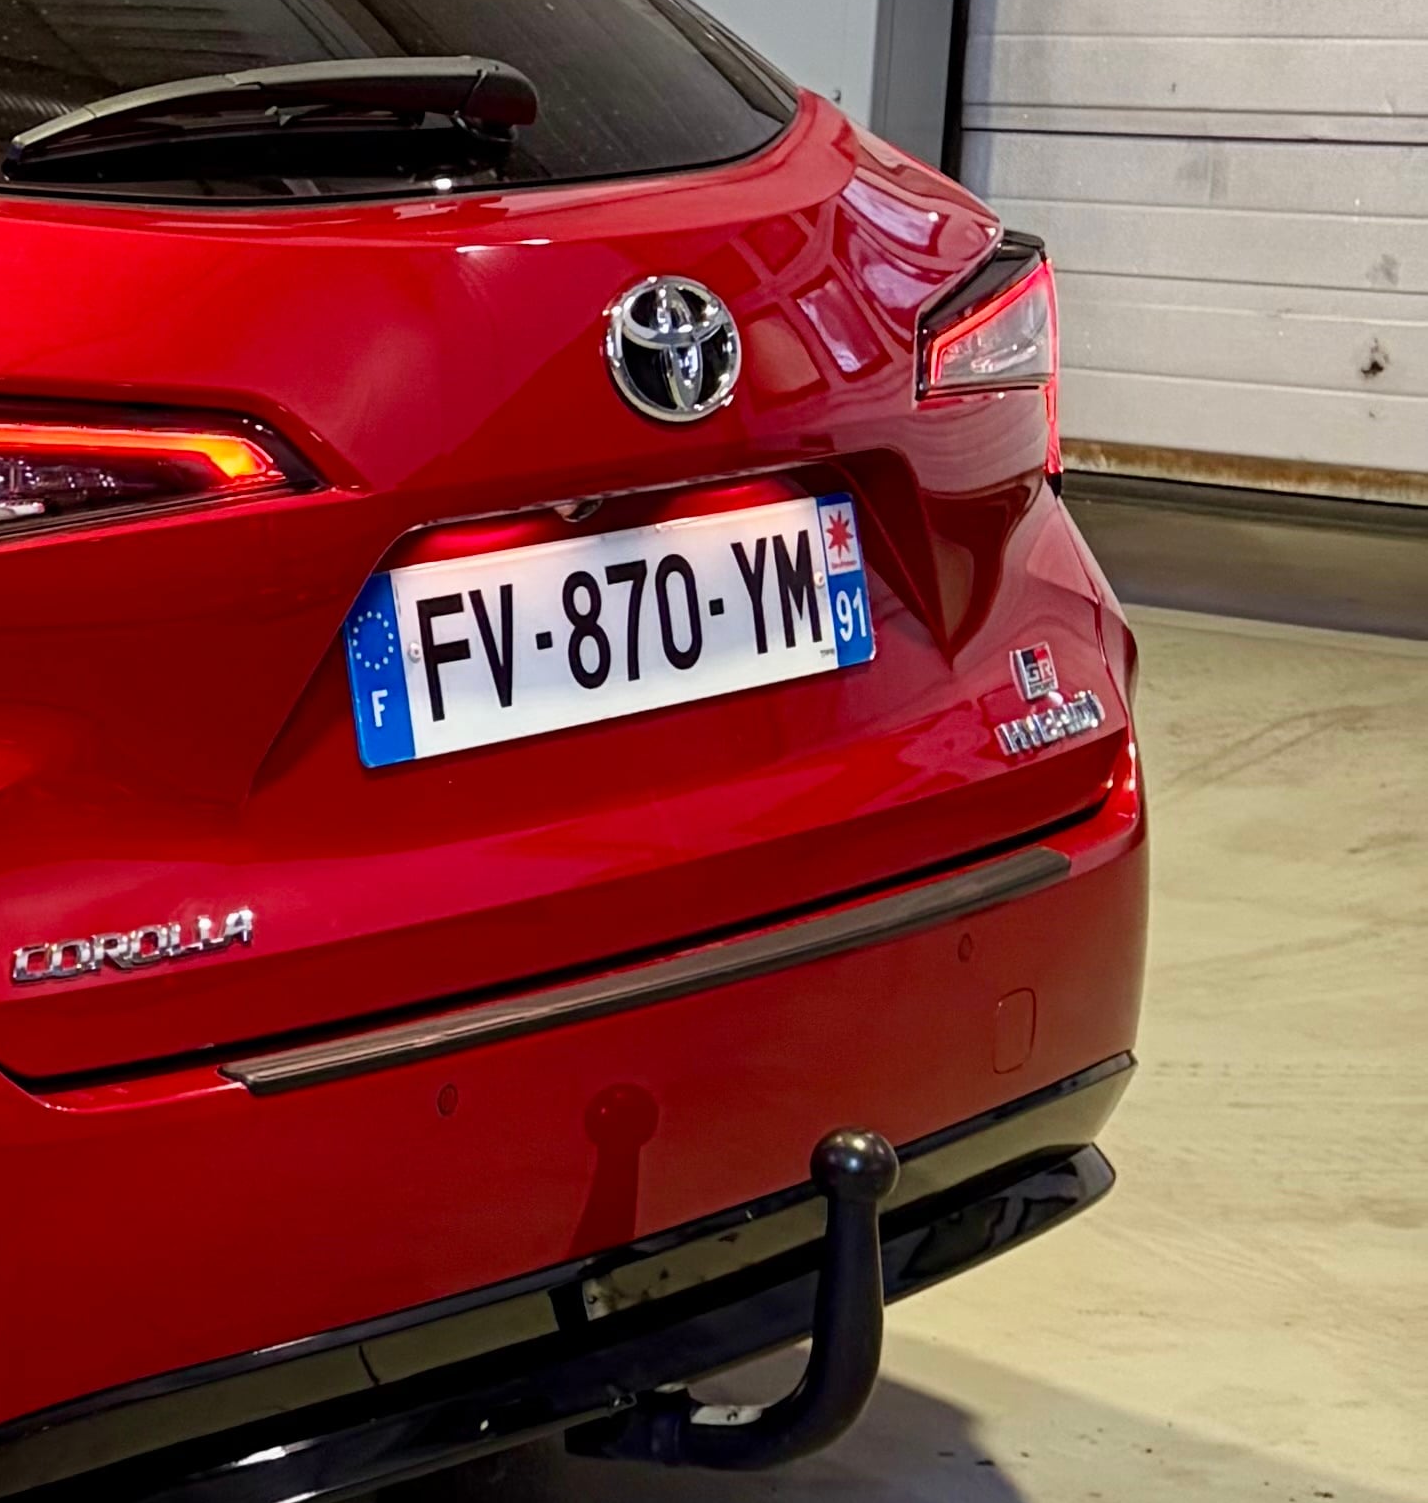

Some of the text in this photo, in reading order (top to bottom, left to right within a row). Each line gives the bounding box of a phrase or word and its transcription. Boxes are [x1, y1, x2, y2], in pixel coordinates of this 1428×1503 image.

[416, 529, 823, 722] FV-870-YM
[835, 586, 868, 643] 91
[371, 689, 389, 728] F
[11, 906, 255, 982] COROLLA
